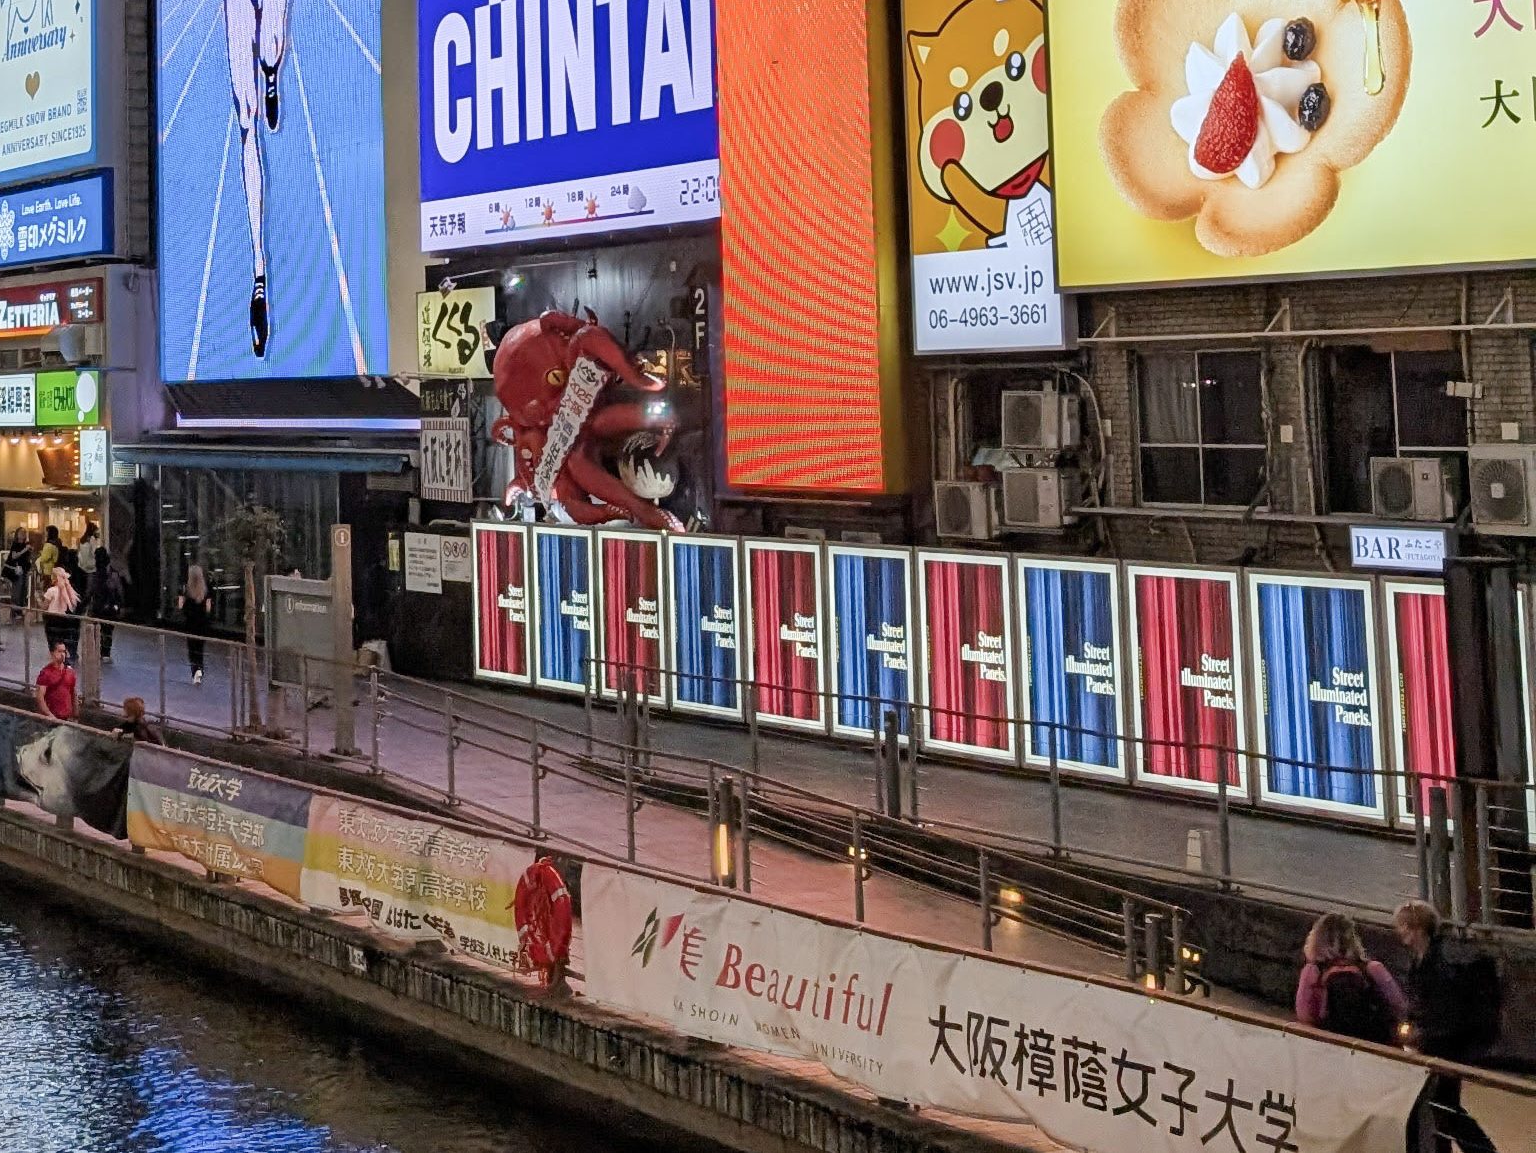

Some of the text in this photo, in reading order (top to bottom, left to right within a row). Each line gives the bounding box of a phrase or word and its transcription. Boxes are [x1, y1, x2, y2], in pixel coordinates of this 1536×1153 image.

[2, 25, 67, 64] Anniversary
[26, 110, 46, 126] SNOW
[47, 103, 72, 121] BRAND
[18, 216, 87, 253] 雪印メグミルク
[429, 212, 467, 240] 天気予報
[929, 265, 1044, 297] www.jsv.jp
[929, 303, 1047, 330] 06-4963-3661
[1355, 535, 1402, 560] BAR
[638, 596, 657, 612] Street
[713, 605, 733, 621] Street
[794, 612, 815, 629] Street
[881, 622, 904, 638] Street
[639, 623, 660, 640] Panels.
[715, 632, 736, 648] Panels.
[978, 631, 1002, 648] Street
[795, 642, 818, 659] Panels.
[1084, 642, 1110, 660] Street
[883, 653, 908, 670] Panels.
[1201, 653, 1230, 674] Street
[980, 663, 1007, 682] Panels.
[1332, 666, 1364, 688] Street
[1085, 676, 1115, 695] Panels.
[1204, 690, 1235, 711] Panels.
[1335, 704, 1372, 726] Panels.
[716, 942, 893, 1037] Beautiful
[690, 1003, 740, 1027] SHOIN
[811, 1040, 884, 1076] UNIVERSITY
[927, 1004, 1300, 1153] 大阪樟蔭女子大学
